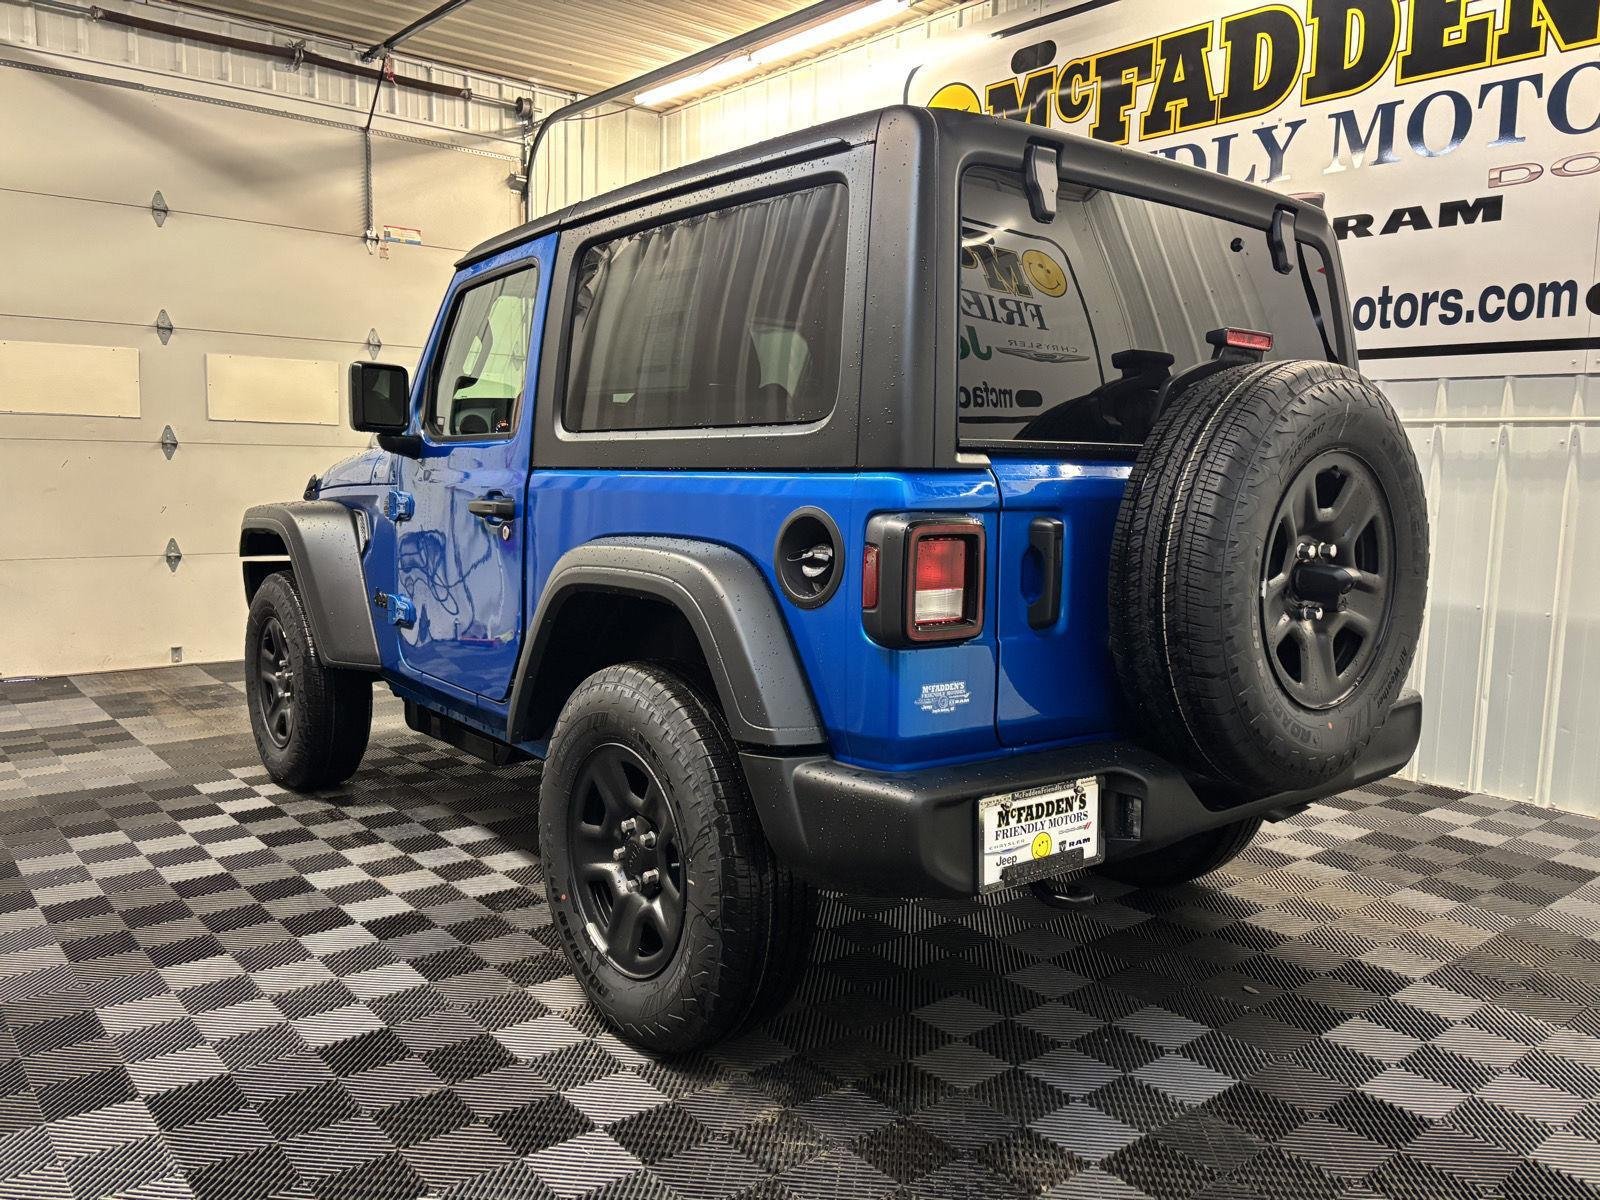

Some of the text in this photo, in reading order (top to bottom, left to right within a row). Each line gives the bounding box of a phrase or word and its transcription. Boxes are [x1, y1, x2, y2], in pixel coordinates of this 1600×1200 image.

[1327, 61, 1600, 167] MOTO
[1333, 195, 1503, 240] RAM
[1353, 279, 1578, 331] otors.com
[995, 810, 1089, 841] FRIENDLY MOTORS
[997, 793, 1087, 828] McFADDEN'S
[1068, 837, 1091, 848] RAM
[995, 854, 1018, 867] Jeep
